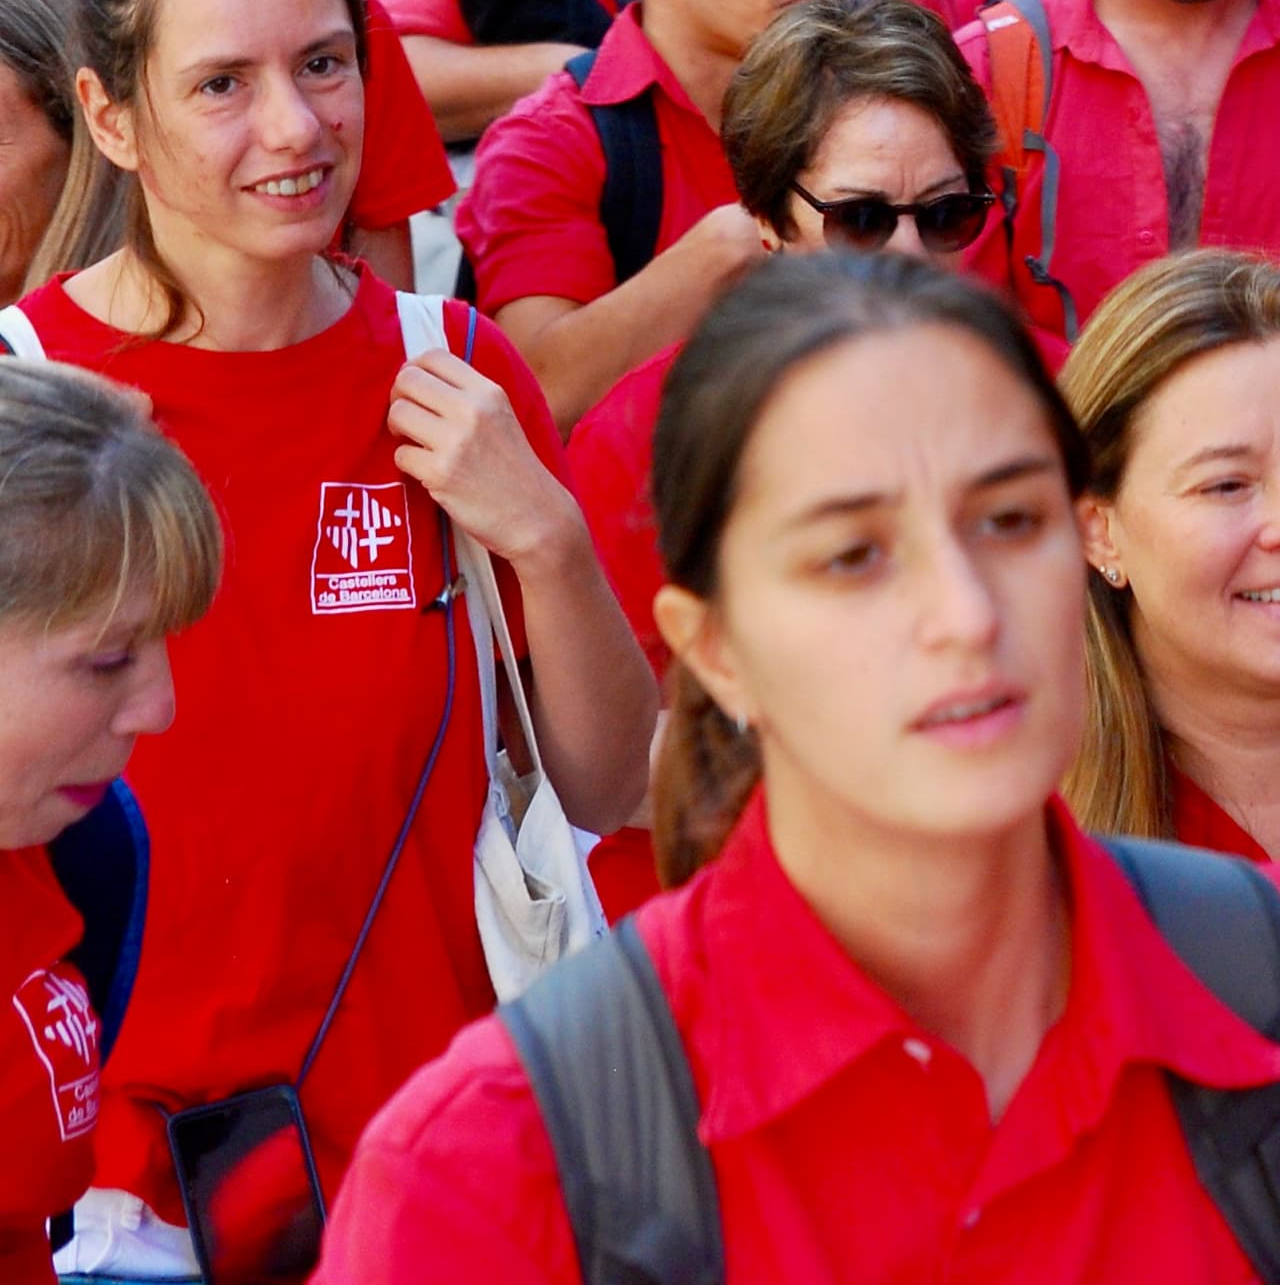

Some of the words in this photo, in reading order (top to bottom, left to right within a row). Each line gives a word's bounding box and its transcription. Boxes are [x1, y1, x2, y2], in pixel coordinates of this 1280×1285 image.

[328, 574, 397, 590] Castellers
[319, 591, 336, 603] de
[339, 587, 408, 603] Barcelona
